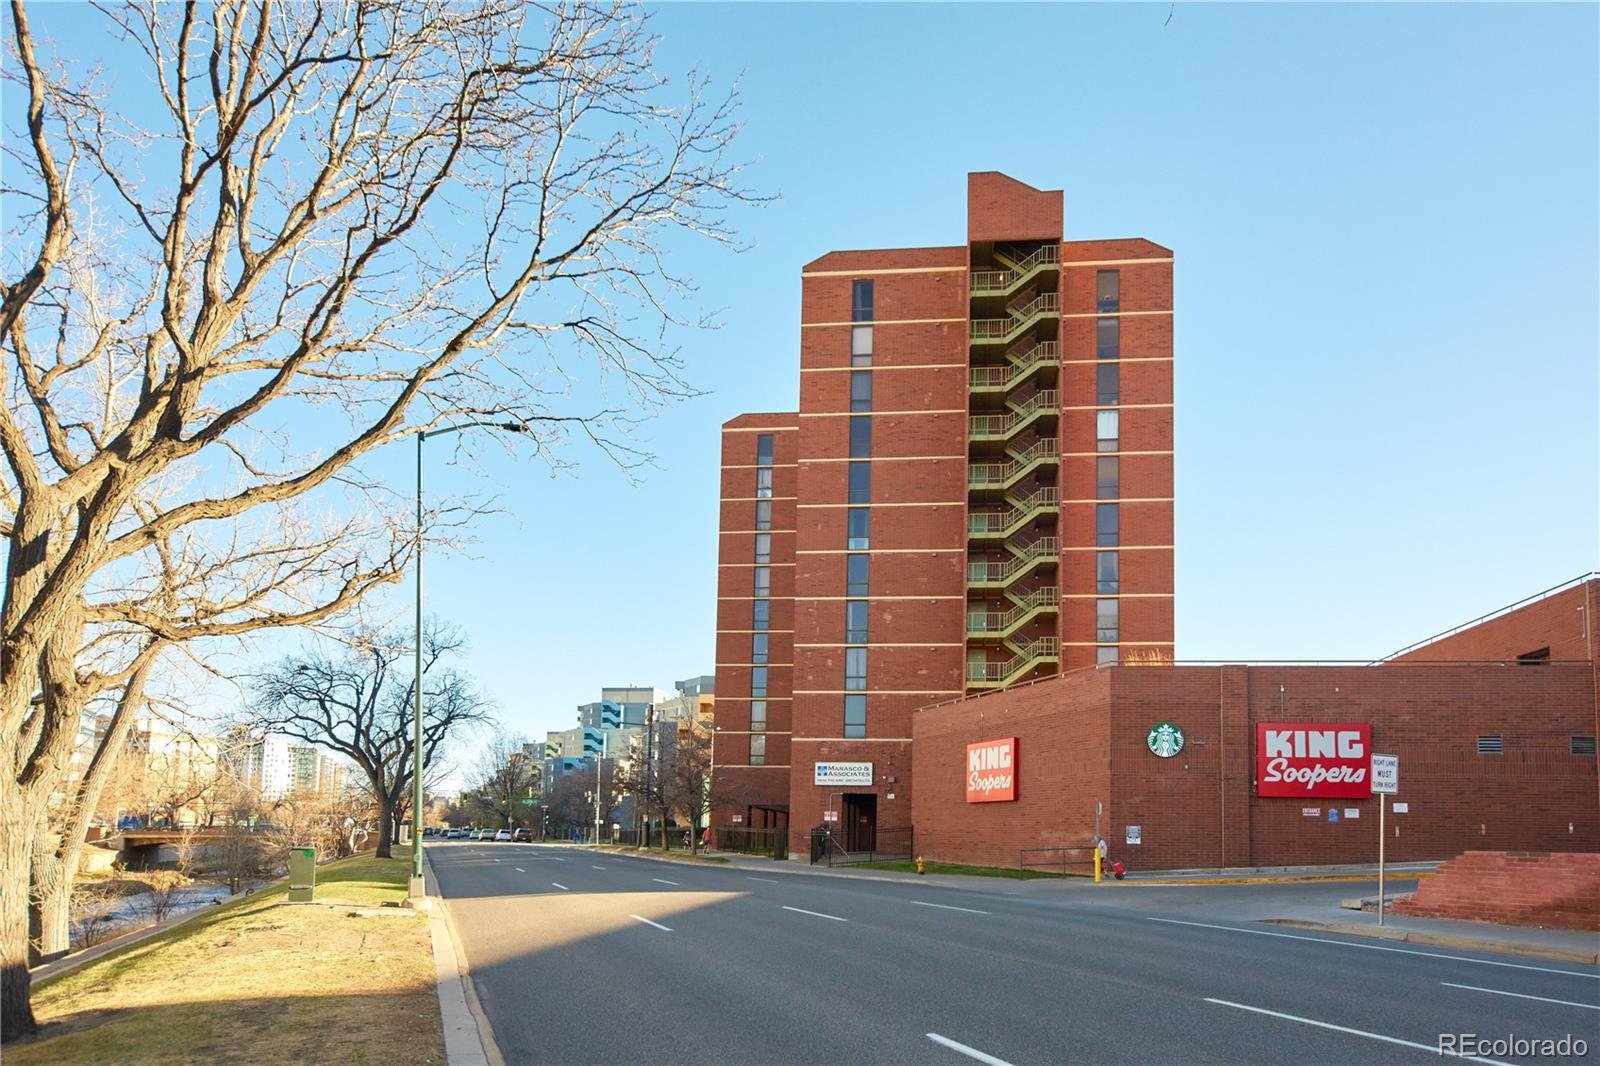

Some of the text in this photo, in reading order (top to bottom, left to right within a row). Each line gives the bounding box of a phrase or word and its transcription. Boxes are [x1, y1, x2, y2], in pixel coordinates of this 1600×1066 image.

[969, 744, 1011, 772] KING
[1265, 730, 1364, 758] KING
[968, 771, 1012, 796] Soopers
[1264, 758, 1366, 789] Soopers
[1377, 770, 1392, 778] MUST
